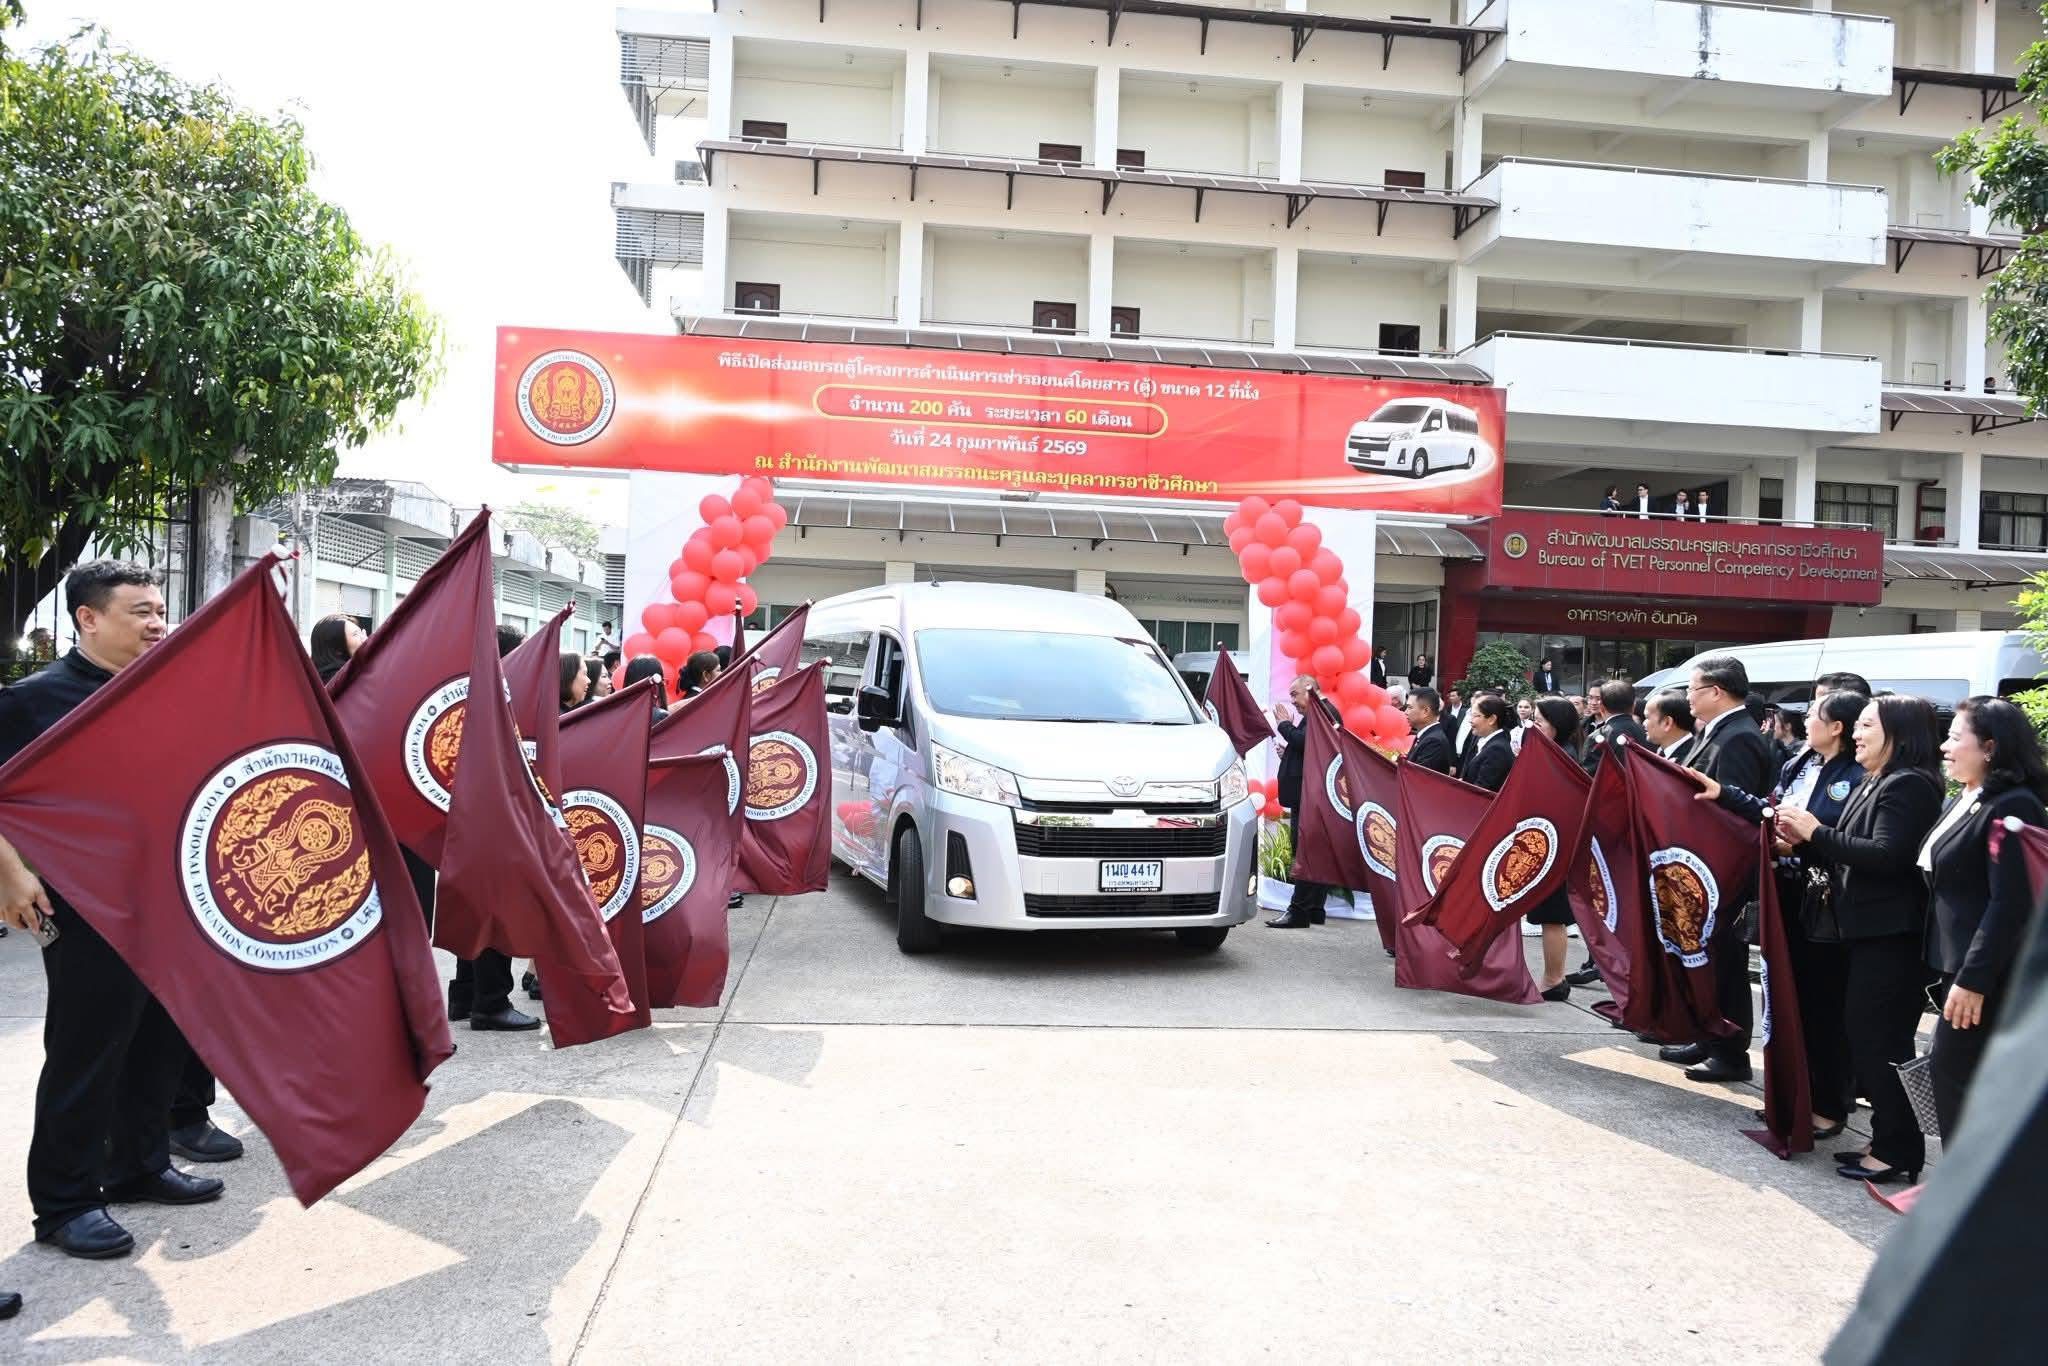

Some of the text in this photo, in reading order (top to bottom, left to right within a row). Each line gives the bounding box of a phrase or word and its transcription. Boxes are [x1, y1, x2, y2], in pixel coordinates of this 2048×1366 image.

[1133, 377, 1157, 400] (ตู้)
[1160, 382, 1201, 396] ขนาด
[1205, 384, 1225, 397] 12
[1229, 380, 1260, 400] ที่นั่ง
[848, 394, 1132, 427] จำนวน 200 คัน ระยะเวลา 60 เดือน
[889, 427, 1088, 455] วันที่ 24 กุมภาพันธ์ 2569
[755, 454, 773, 469] ณ
[1538, 549, 1877, 582] Bureau of TVET Personnel Competency Development
[1567, 608, 1647, 625] อาคารหอพัก
[189, 789, 340, 961] VOCATIONAL EDUCATION COMMISSION
[1131, 863, 1159, 876] 4417
